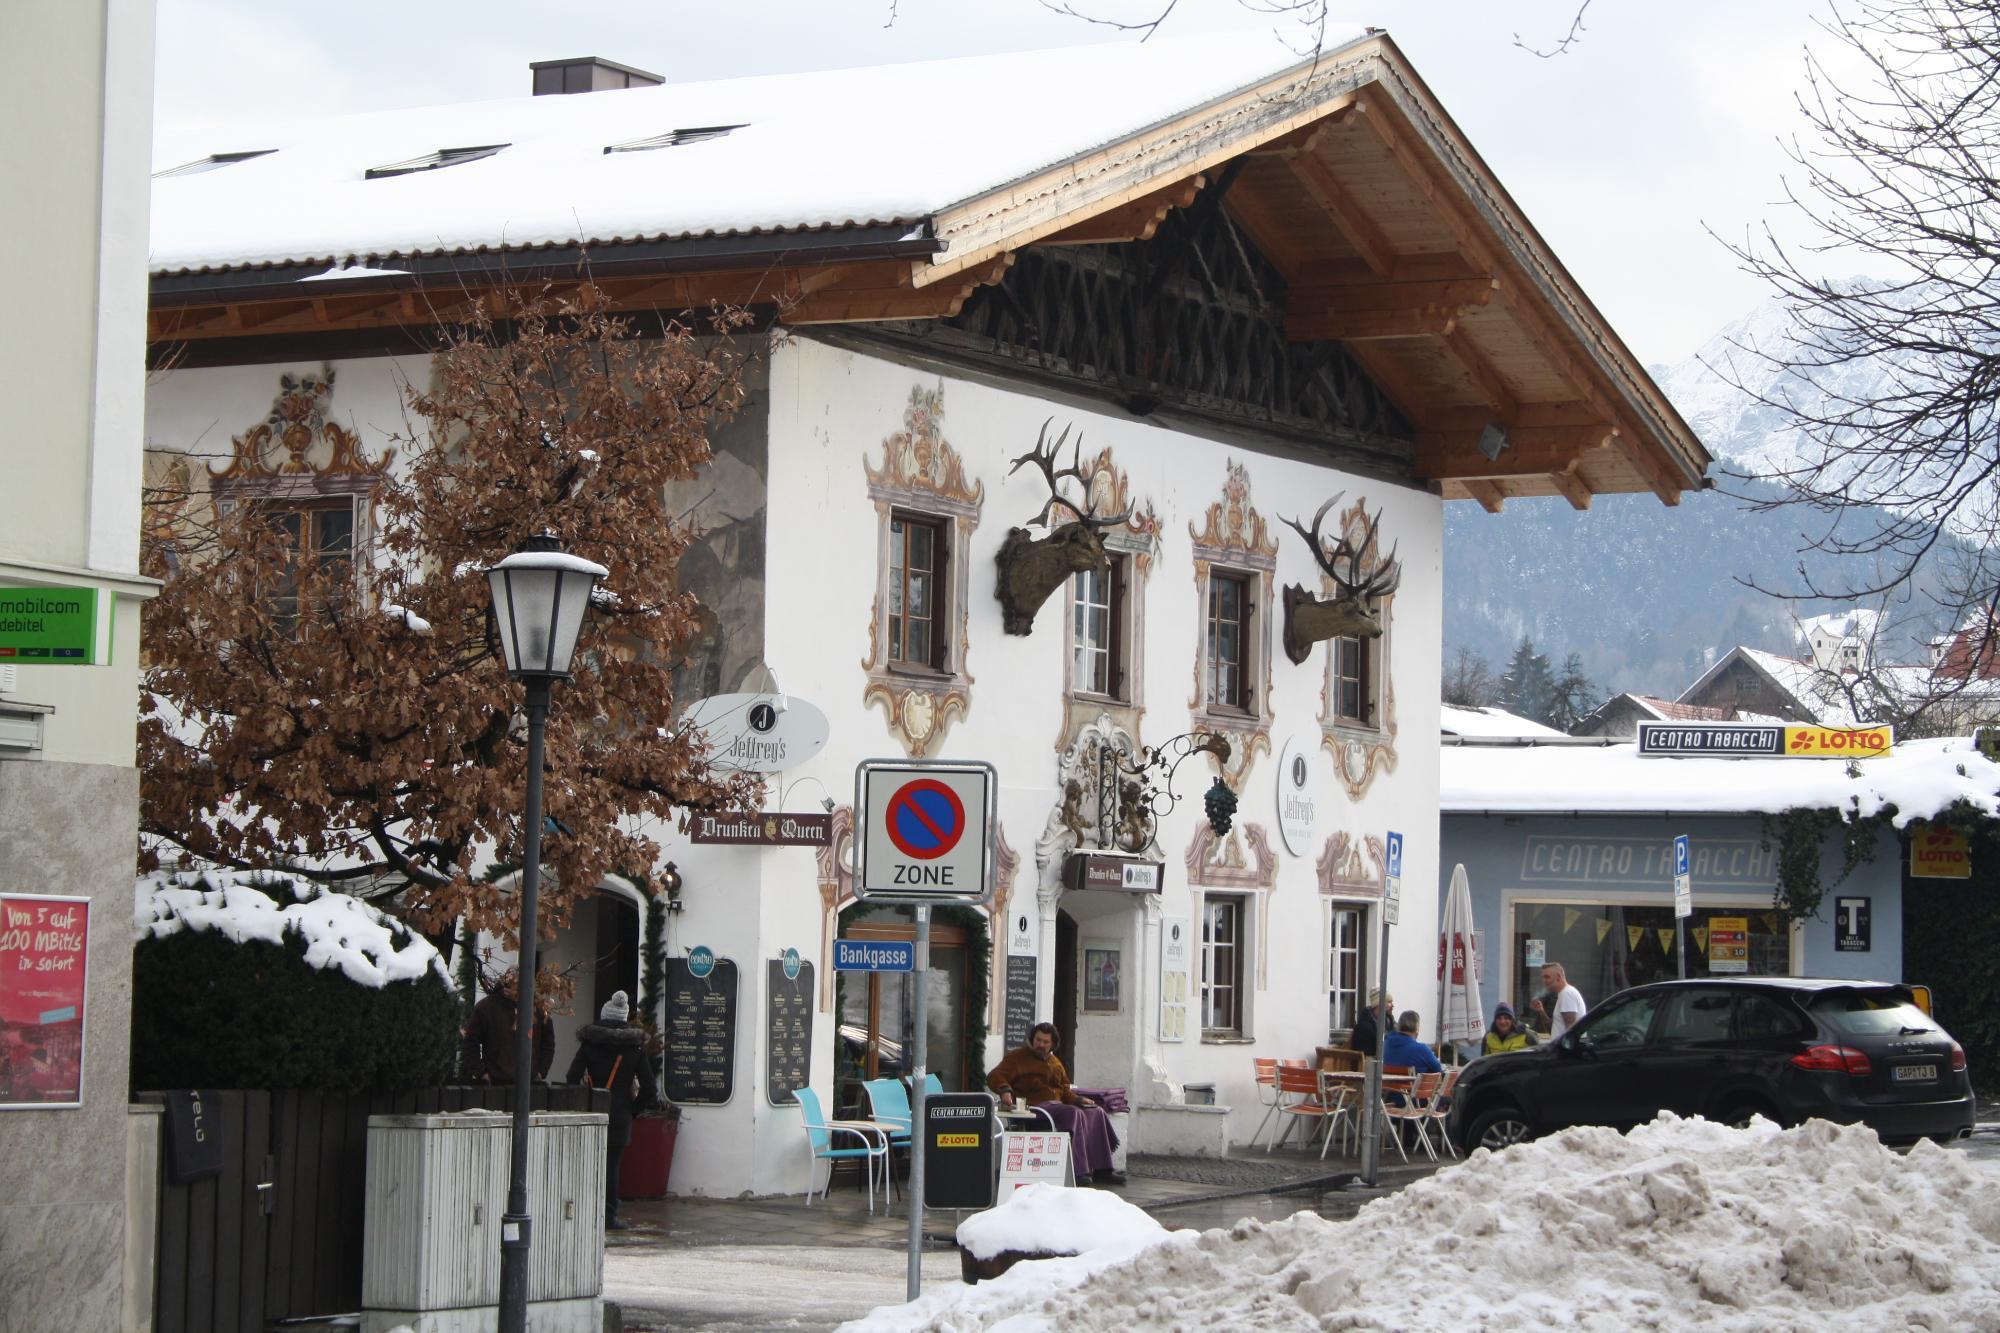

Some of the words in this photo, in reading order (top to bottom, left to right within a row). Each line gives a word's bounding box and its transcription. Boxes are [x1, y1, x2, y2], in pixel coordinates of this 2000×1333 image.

[0, 598, 80, 614] mobilcom
[0, 618, 45, 632] debitel
[730, 735, 787, 763] Jeffrey's
[1650, 732, 1701, 749] CENTRO
[1706, 730, 1774, 748] TABACCHI
[1820, 733, 1885, 749] LOTTO
[1285, 794, 1314, 825] Jeffrey's
[699, 816, 761, 838] Drunken
[780, 818, 824, 840] Queen
[1389, 837, 1399, 873] P
[1532, 844, 1633, 879] CENTRO
[1643, 843, 1776, 877] TAACCHI
[1677, 842, 1685, 873] P
[1919, 850, 1963, 862] LOTTO
[893, 865, 954, 885] ZONE
[8, 907, 32, 929] Von
[38, 907, 48, 926] 5
[50, 907, 77, 930] auf
[1841, 899, 1865, 935] T
[1, 929, 30, 951] 100
[19, 955, 33, 970] in
[36, 956, 75, 972] sofort
[840, 944, 907, 969] Bankgasse
[1027, 1159, 1058, 1167] Computer
